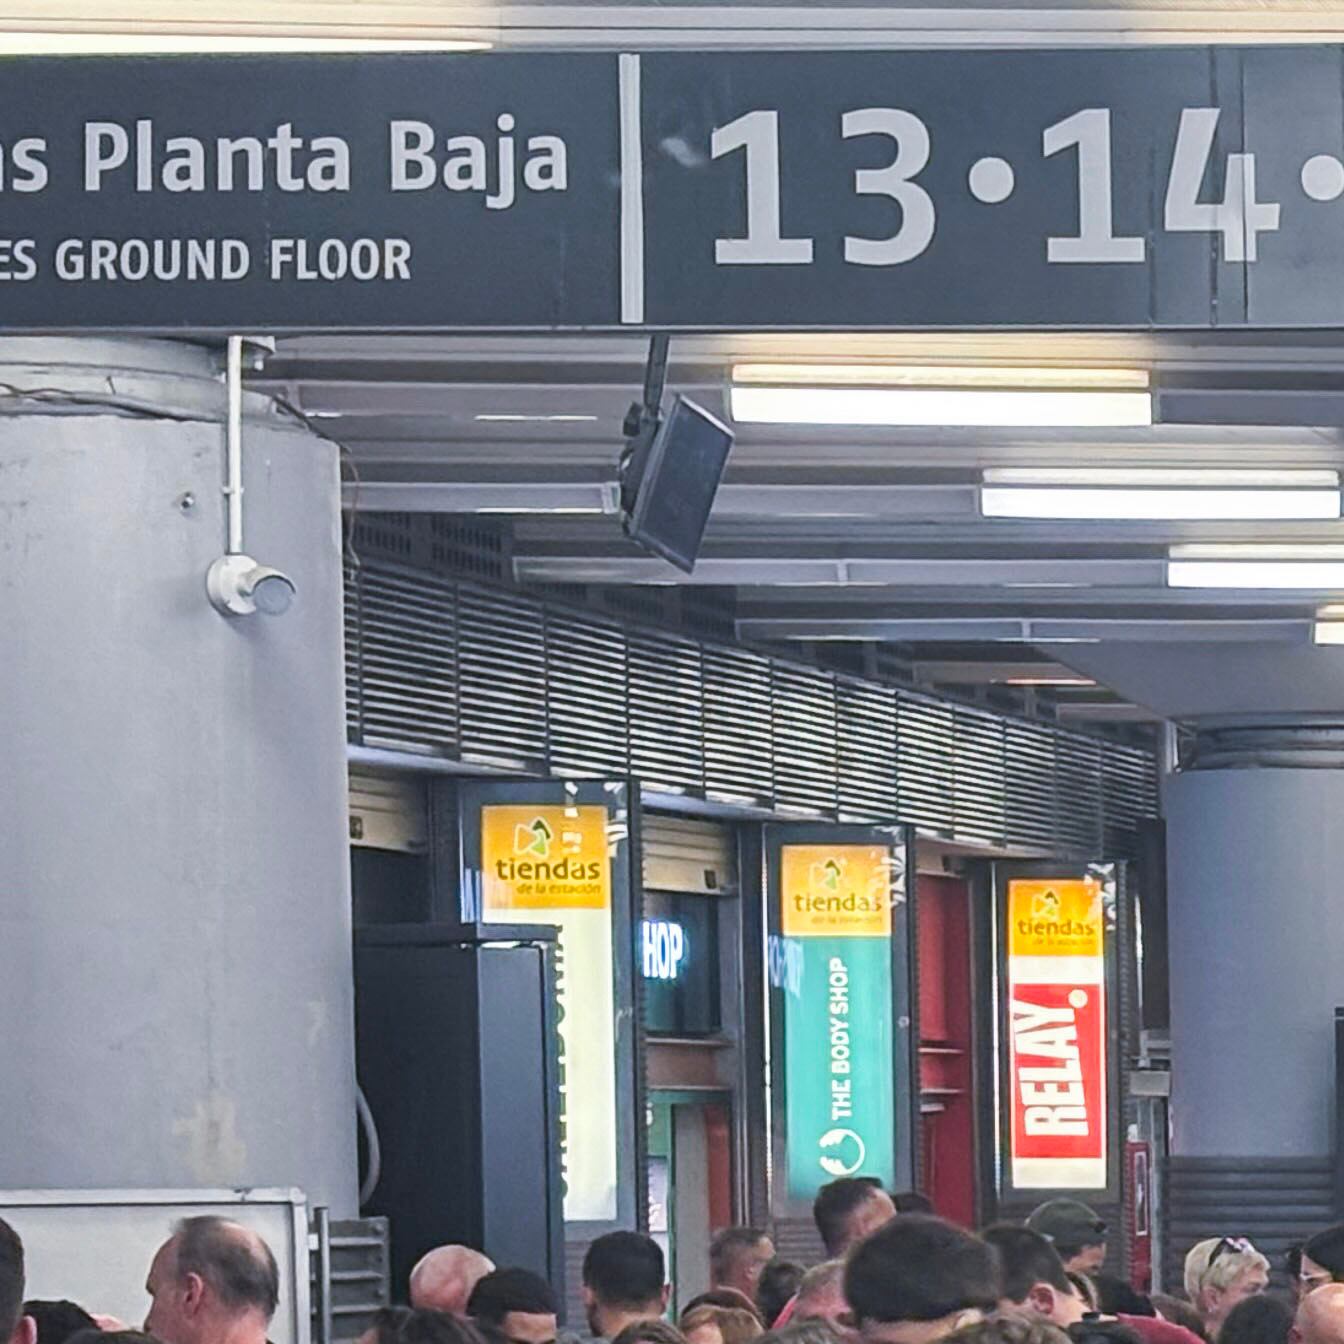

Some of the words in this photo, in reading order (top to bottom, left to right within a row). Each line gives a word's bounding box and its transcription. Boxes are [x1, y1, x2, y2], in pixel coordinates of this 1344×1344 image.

[86, 120, 350, 192] Planta
[391, 114, 567, 210] Baja
[56, 239, 250, 281] GROUND
[272, 238, 411, 281] FLOOR
[496, 858, 601, 881] tiendas
[517, 882, 532, 894] de
[536, 882, 546, 894] la
[794, 893, 882, 912] tiendas
[1017, 919, 1095, 937] tiendas
[829, 957, 849, 1015] SHOP
[831, 1017, 850, 1075] BODY
[831, 1079, 853, 1120] THE
